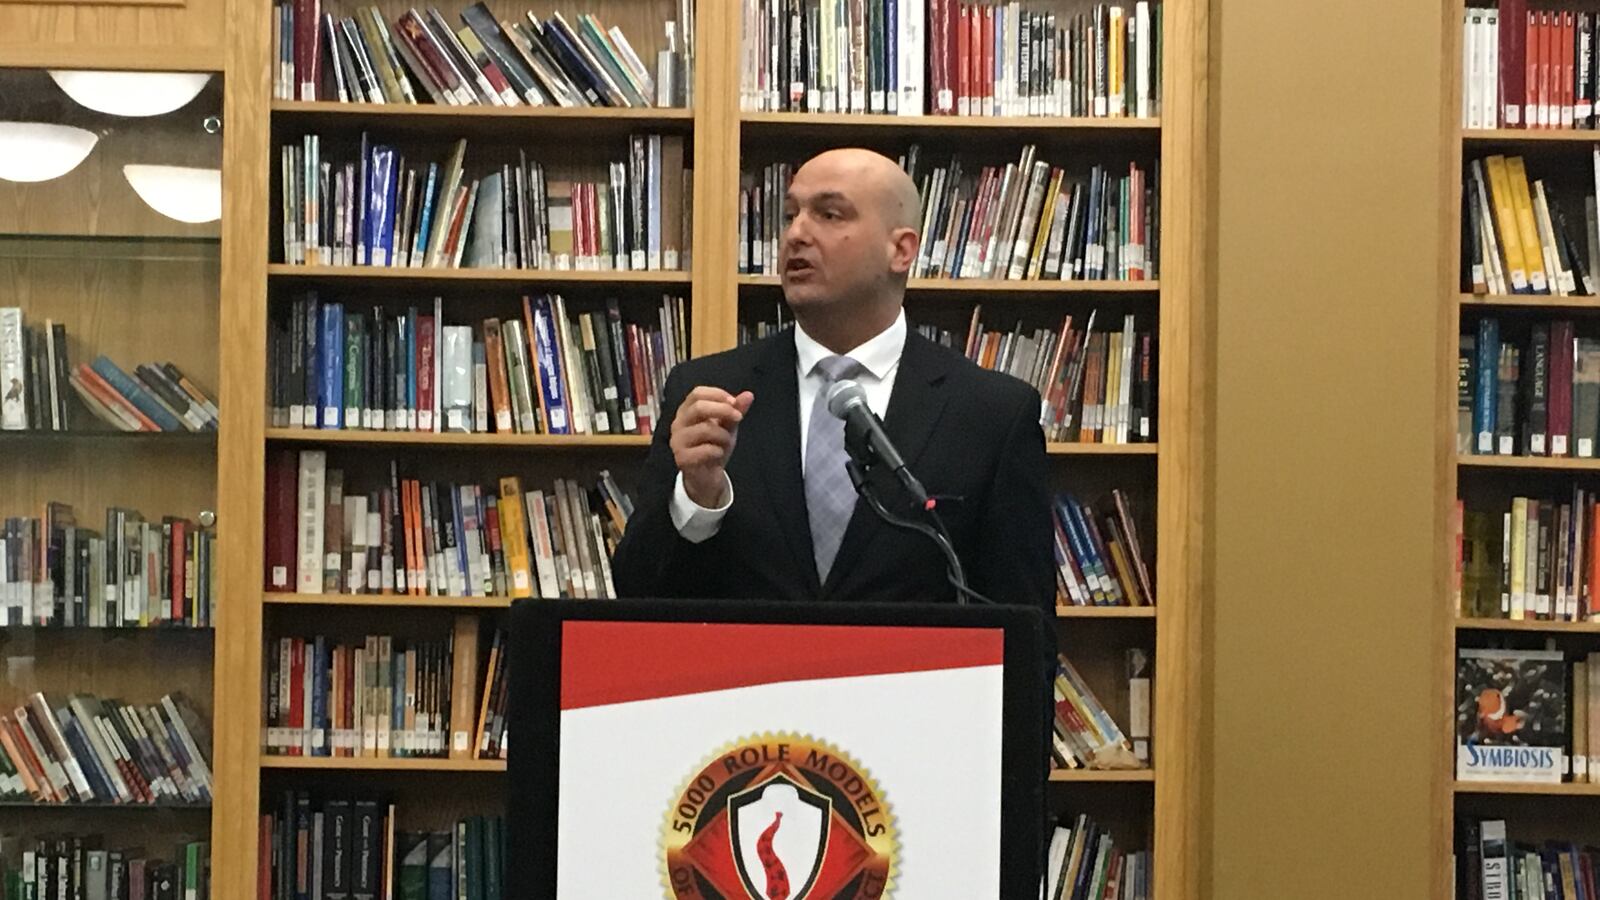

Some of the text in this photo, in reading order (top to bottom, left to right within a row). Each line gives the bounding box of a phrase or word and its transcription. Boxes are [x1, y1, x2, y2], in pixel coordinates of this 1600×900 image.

[1534, 344, 1545, 398] LANGUAGE
[1466, 736, 1554, 768] SYMBIOSIS
[672, 743, 886, 838] 5000 ROLE MODELS
[673, 867, 693, 896] OF
